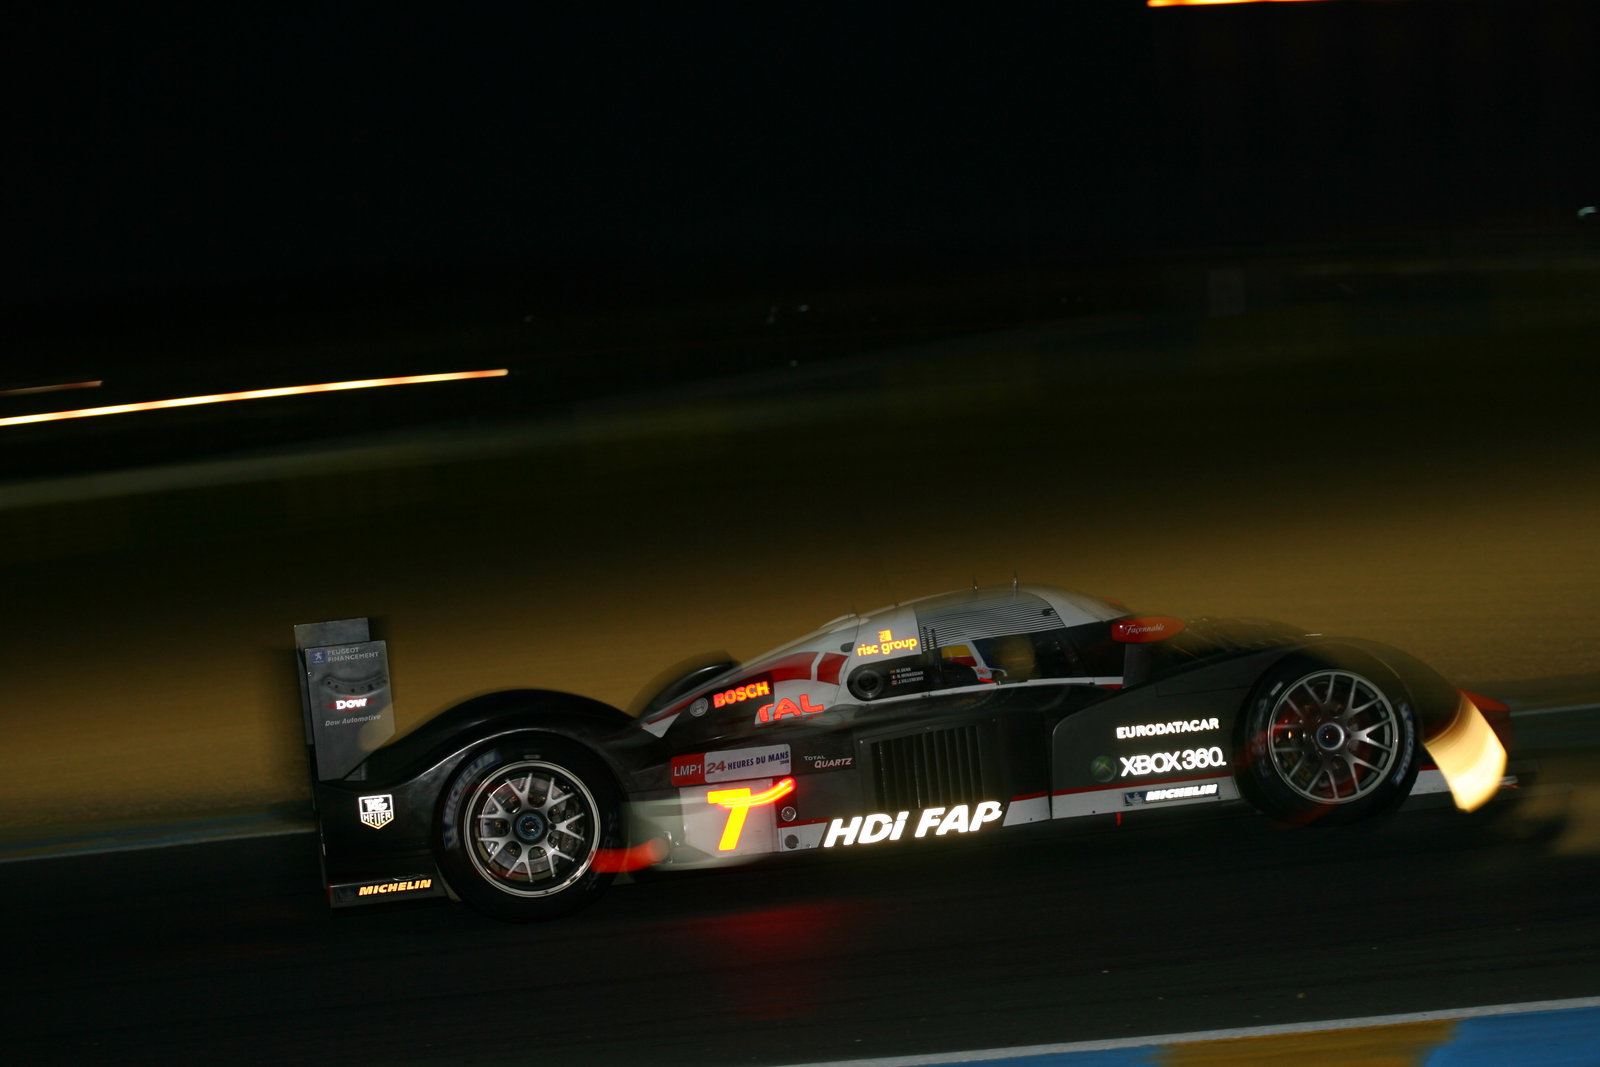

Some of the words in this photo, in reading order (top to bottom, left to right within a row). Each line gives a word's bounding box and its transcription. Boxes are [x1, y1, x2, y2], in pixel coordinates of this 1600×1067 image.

[328, 646, 359, 656] PEUGEOT
[857, 643, 879, 657] risc
[881, 638, 918, 655] group
[328, 651, 379, 663] FINANCEMENT
[713, 680, 772, 708] BOSCH
[324, 717, 341, 727] Dow
[342, 713, 382, 726] Automotive
[1116, 717, 1220, 739] EURODATACAR
[705, 760, 727, 775] 24
[727, 758, 754, 771] HEURES
[756, 756, 767, 765] DU
[768, 751, 790, 763] MANS
[803, 754, 827, 762] TOTAL
[814, 757, 853, 769] QUARTZ
[673, 764, 703, 777] LMP1
[1145, 783, 1218, 801] MICHELIN
[363, 812, 392, 826] HEUER
[823, 811, 909, 848] HDi
[915, 801, 1003, 838] FAP
[358, 879, 432, 896] MICHELIN
